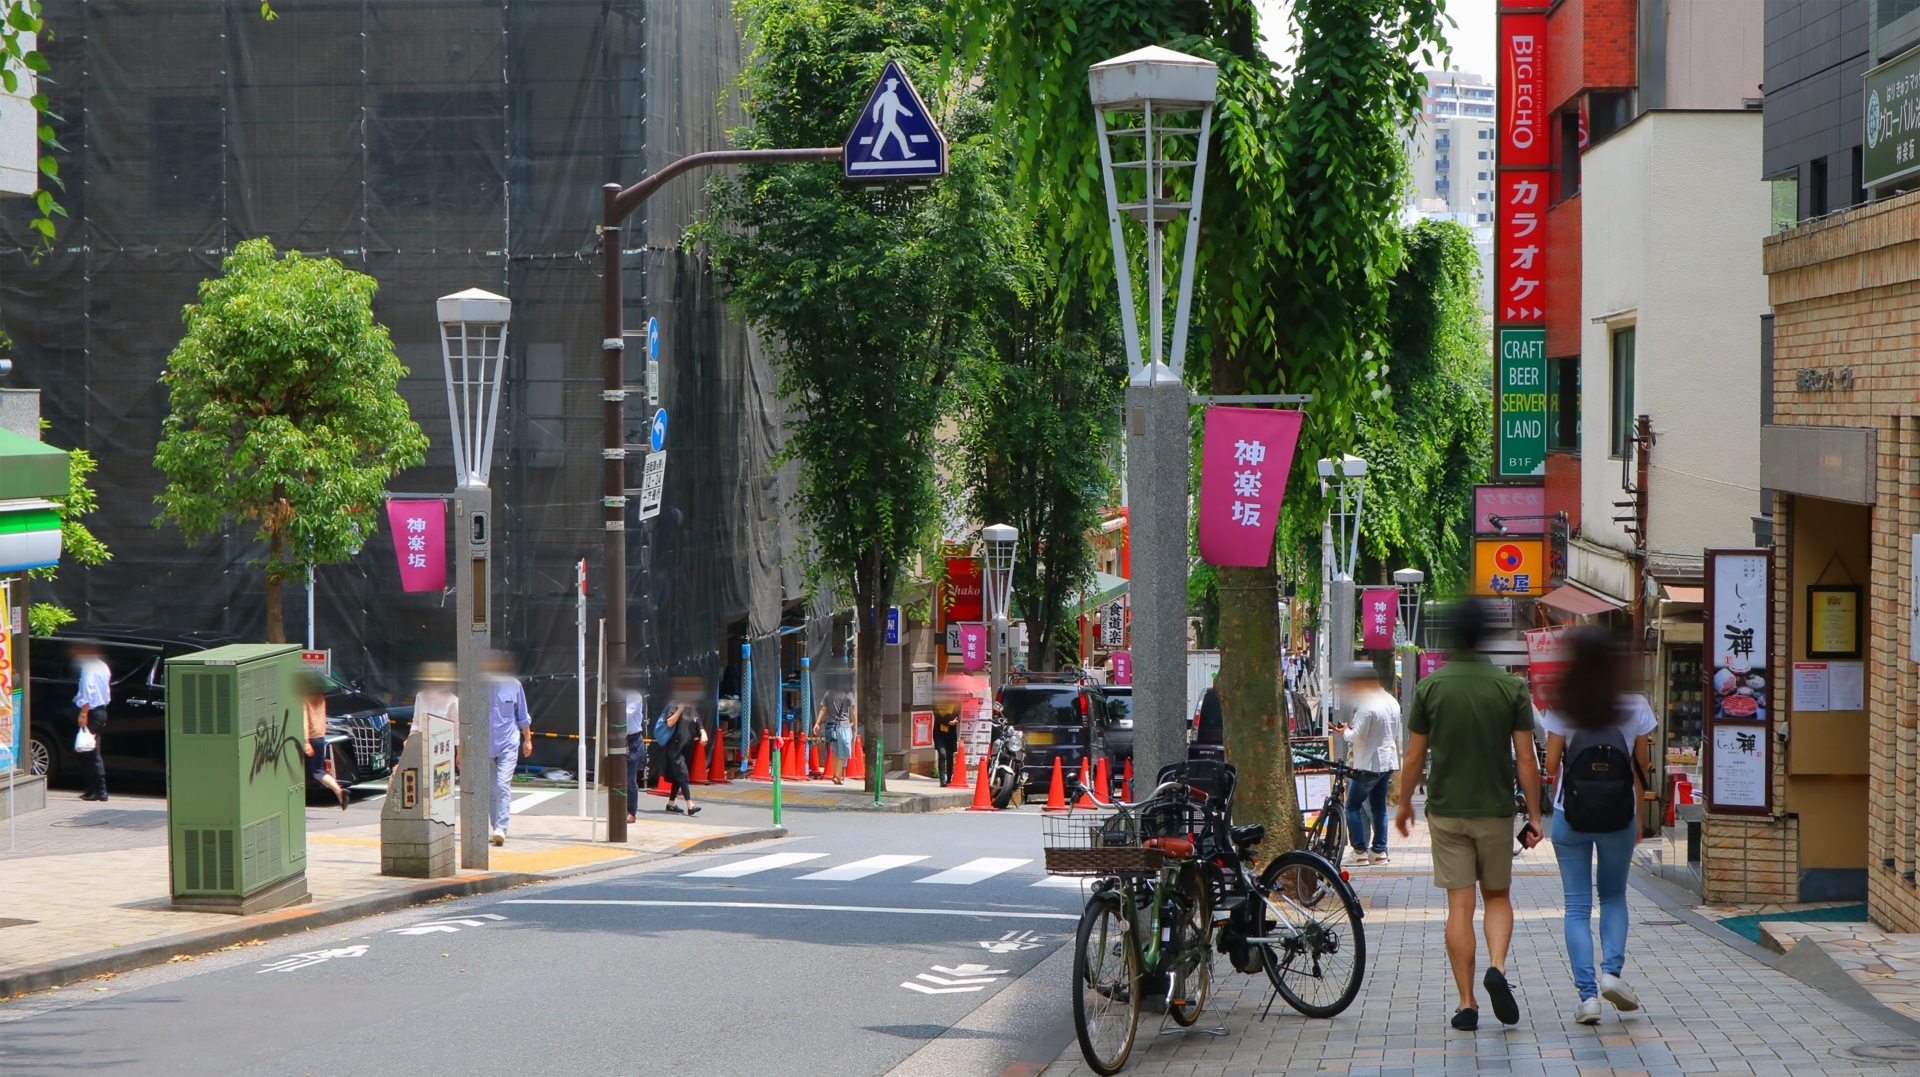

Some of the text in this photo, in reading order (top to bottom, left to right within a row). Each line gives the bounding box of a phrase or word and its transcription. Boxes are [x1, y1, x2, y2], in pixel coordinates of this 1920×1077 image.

[1512, 36, 1534, 149] BIG ECHO
[1510, 180, 1540, 301] カラオケ
[1504, 341, 1544, 359] CRAFT
[1509, 367, 1539, 385] BEER
[1502, 393, 1545, 412] SERVER
[1506, 420, 1541, 438] LAND
[1509, 458, 1532, 467] B1F
[1232, 440, 1266, 527] 神楽坂
[407, 517, 426, 568] 神楽坂
[953, 585, 981, 596] hako
[1489, 573, 1530, 593] 松屋
[1109, 602, 1122, 644] 食道楽
[1374, 601, 1387, 635] 神楽坂
[967, 634, 977, 660] 神楽坂
